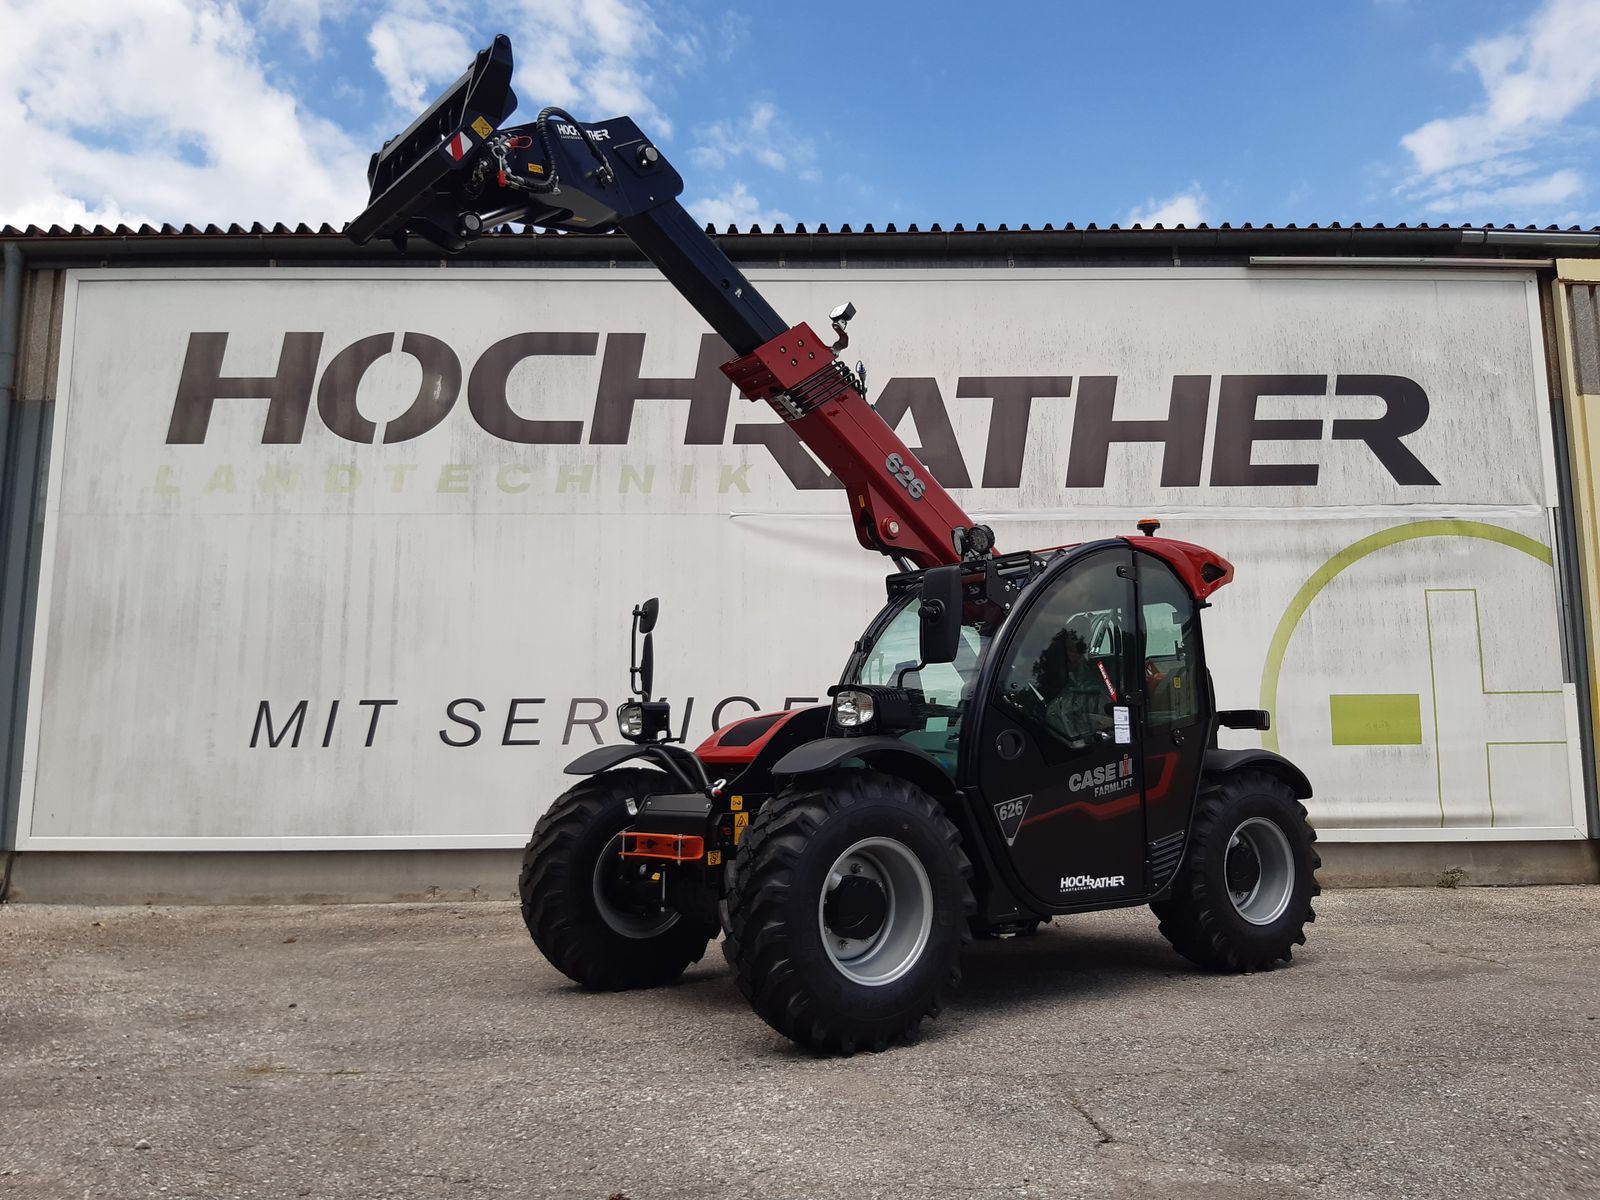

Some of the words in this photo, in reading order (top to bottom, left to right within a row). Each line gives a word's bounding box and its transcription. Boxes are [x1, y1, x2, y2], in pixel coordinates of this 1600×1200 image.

[153, 463, 753, 495] LANDTECHNIK
[886, 452, 926, 499] 626
[249, 699, 398, 748] MIT
[438, 696, 820, 747] SERIC
[1068, 762, 1117, 792] CASE
[1094, 777, 1134, 798] FARMLIFT
[999, 800, 1024, 821] 626
[1060, 874, 1126, 889] HOCHRATHER
